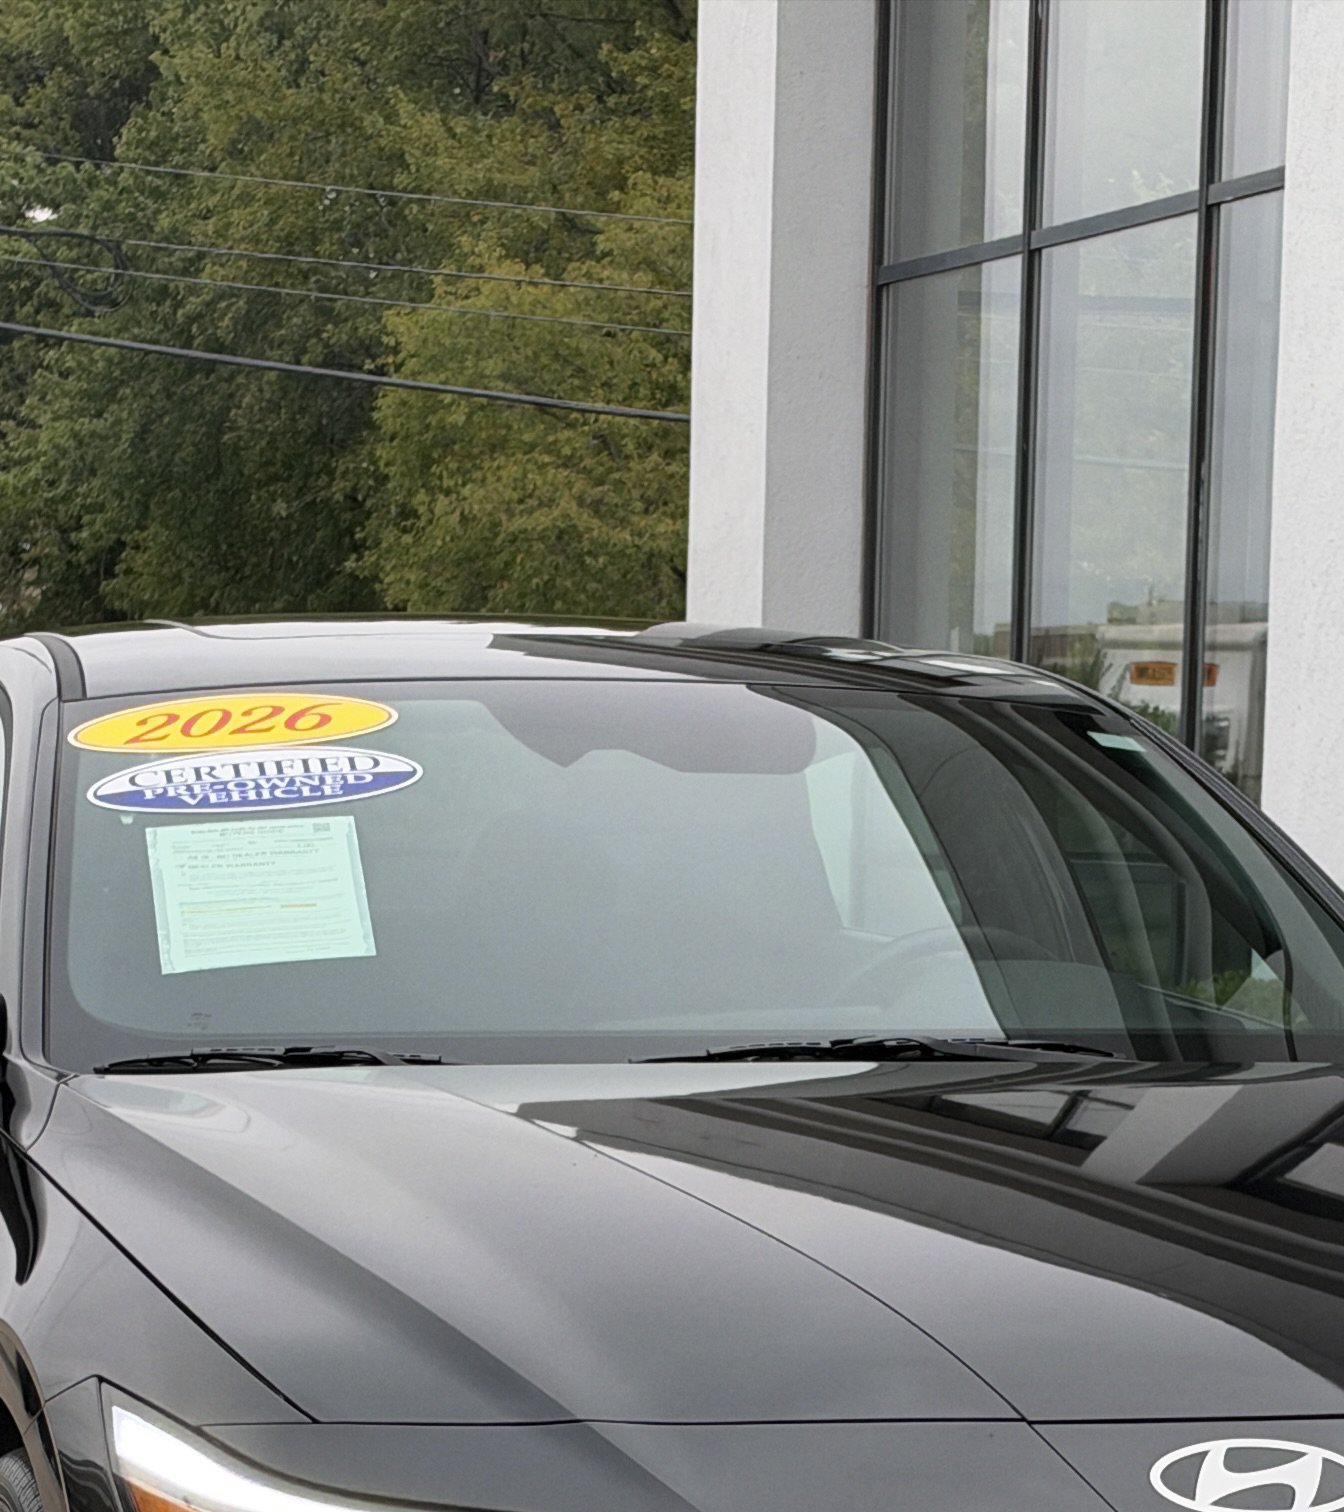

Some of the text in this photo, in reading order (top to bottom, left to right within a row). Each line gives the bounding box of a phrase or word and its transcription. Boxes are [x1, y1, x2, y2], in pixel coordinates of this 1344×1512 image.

[123, 703, 344, 745] 2026
[128, 755, 381, 788] CERTIFIED
[143, 772, 374, 801] PRE-OWNED
[179, 783, 344, 806] VEHICLE
